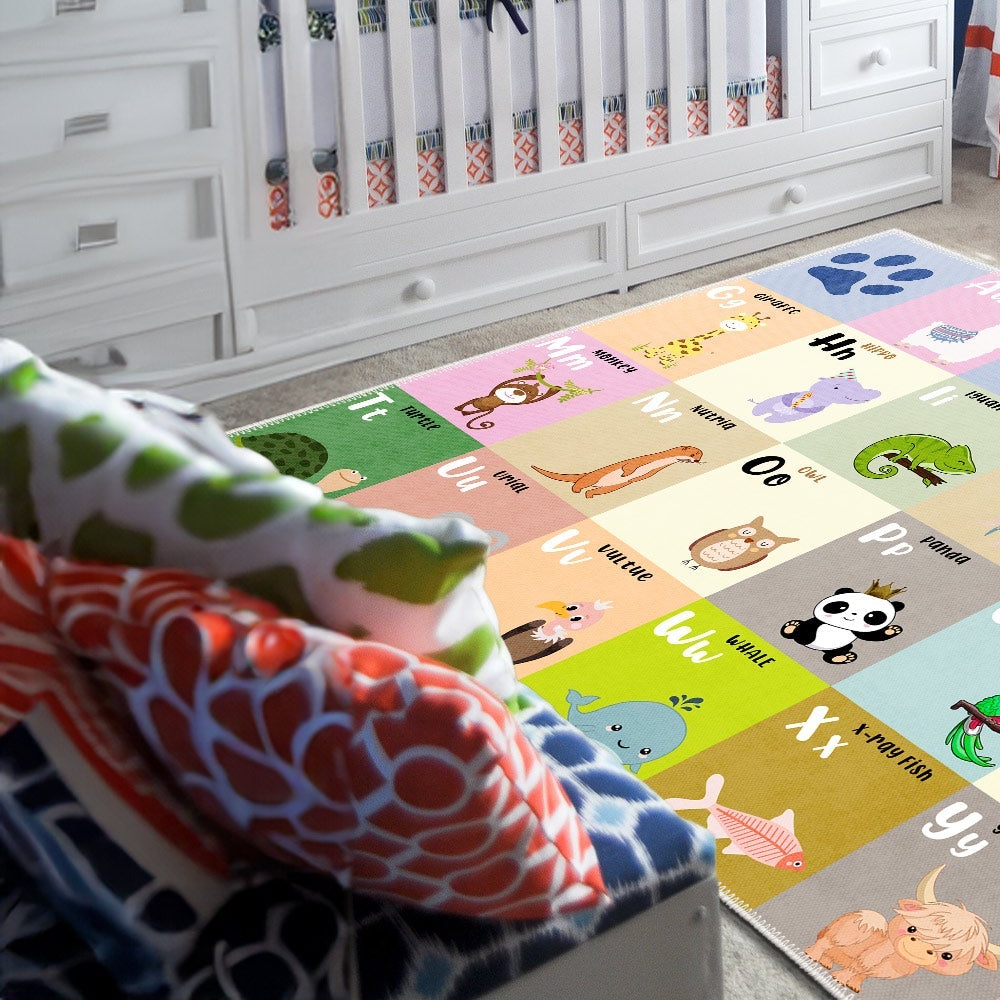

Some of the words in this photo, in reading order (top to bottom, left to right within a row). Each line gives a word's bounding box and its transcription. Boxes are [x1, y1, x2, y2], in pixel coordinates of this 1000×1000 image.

[706, 285, 746, 309] Gg
[535, 335, 594, 372] Mm
[808, 332, 857, 361] Hh
[347, 391, 394, 421] Tt
[631, 391, 685, 425] Nn
[437, 455, 487, 493] Uu
[741, 455, 792, 487] Oo
[541, 528, 593, 566] Vv
[857, 521, 914, 557] Pp
[653, 610, 724, 664] Ww
[725, 634, 776, 668] WHALE
[785, 705, 849, 759] Xx
[921, 801, 989, 858] Yy
